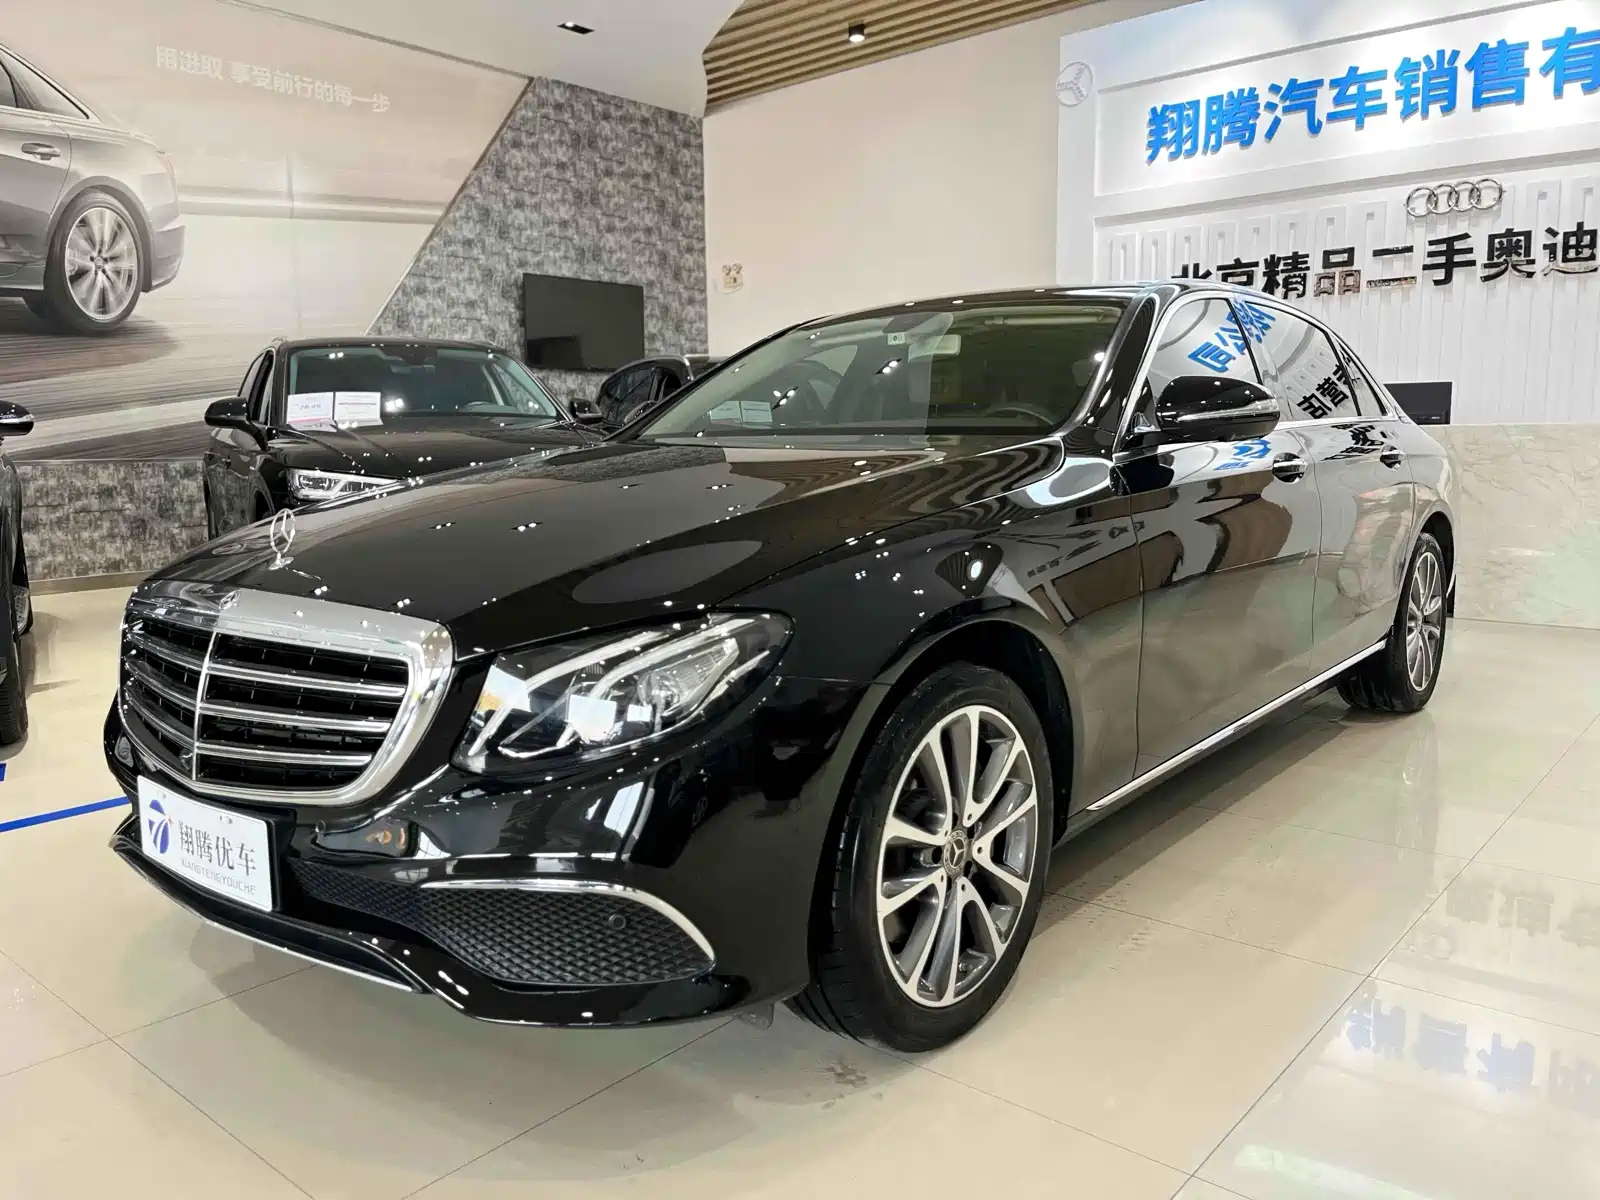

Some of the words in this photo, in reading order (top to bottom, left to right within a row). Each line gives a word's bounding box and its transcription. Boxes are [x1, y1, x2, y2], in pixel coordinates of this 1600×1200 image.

[228, 61, 390, 112] 享受前行的每一步
[1145, 27, 1600, 164] 翔腾汽车销售有
[179, 821, 256, 876] 翔腾优车
